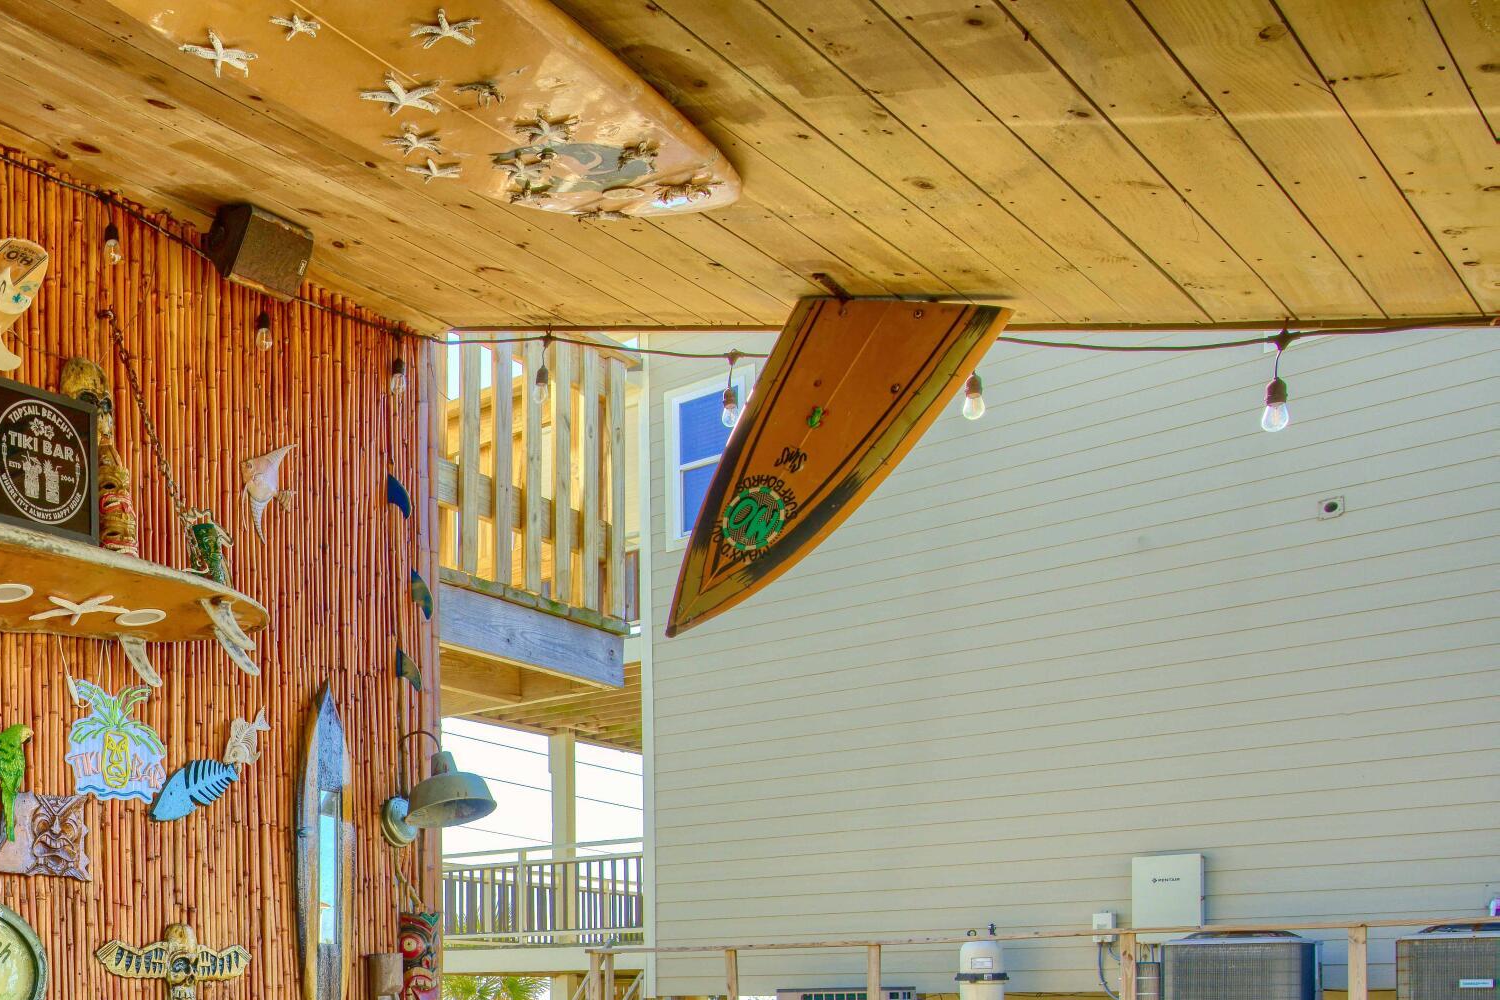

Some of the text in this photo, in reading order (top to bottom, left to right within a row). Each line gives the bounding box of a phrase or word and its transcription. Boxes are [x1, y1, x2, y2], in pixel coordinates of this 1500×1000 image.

[8, 405, 74, 440] TOPSAIL BEACH'S
[8, 430, 75, 462] TIKI BAR
[1, 472, 82, 520] WHERE IT'S ALWAYS HAPPY HOUR
[737, 474, 799, 520] SURFBOARDS
[130, 752, 166, 790] BAR
